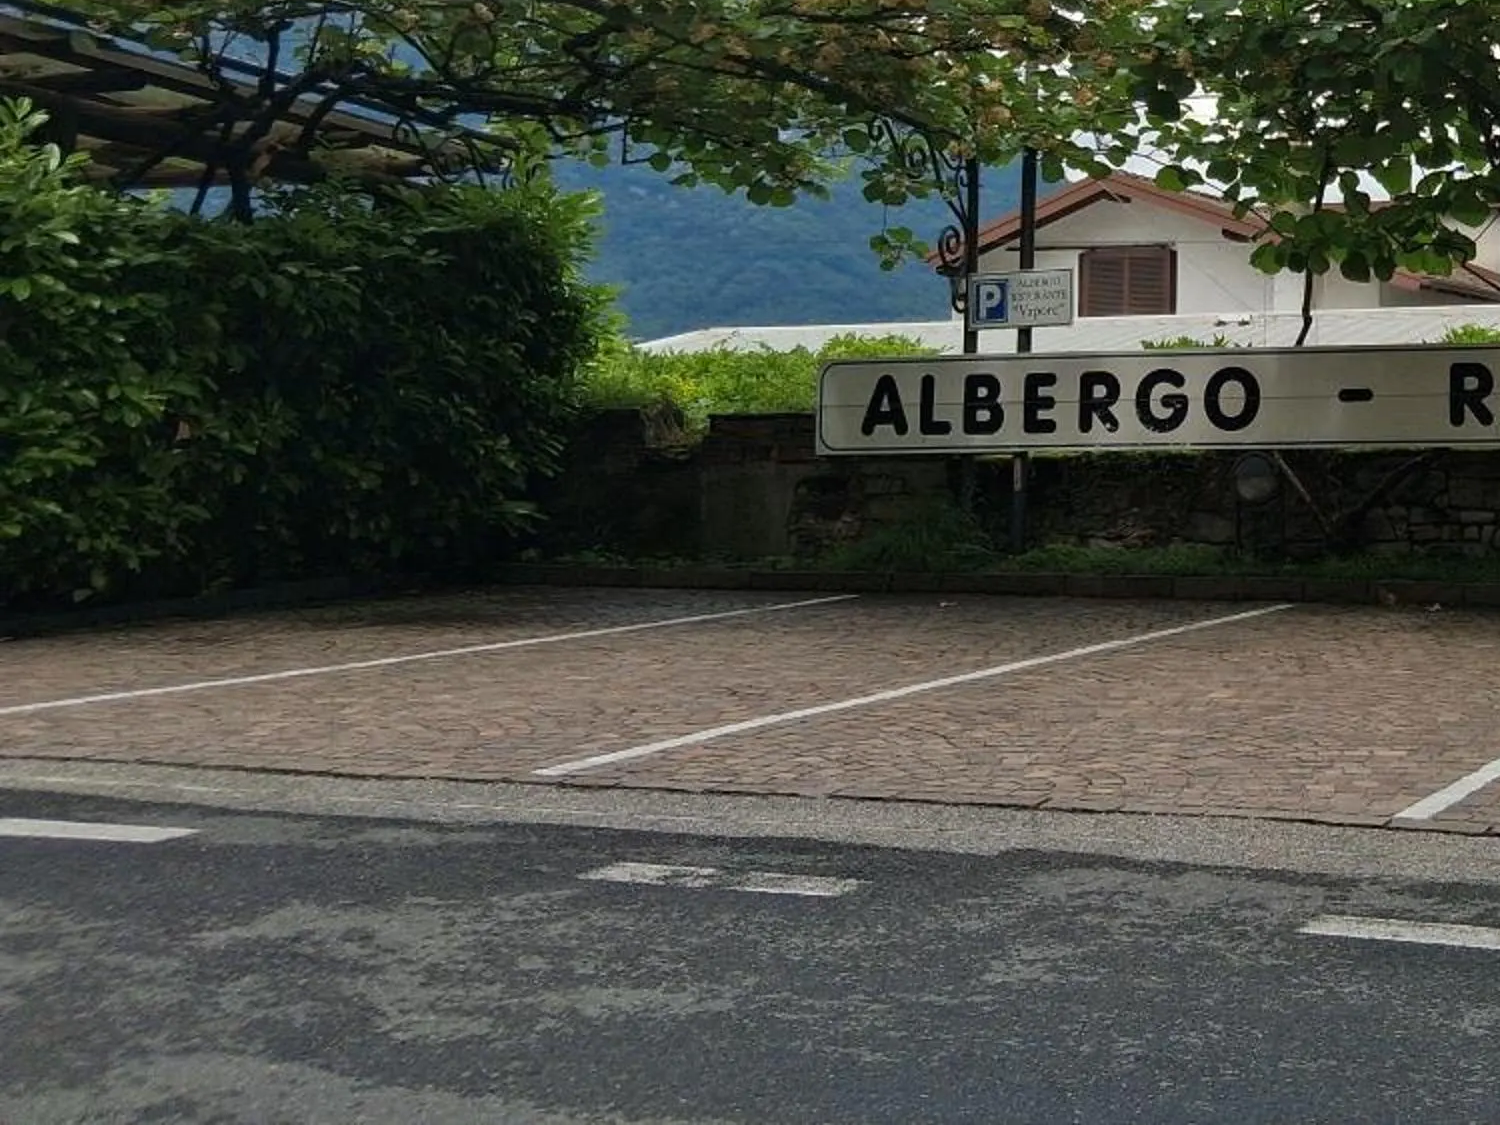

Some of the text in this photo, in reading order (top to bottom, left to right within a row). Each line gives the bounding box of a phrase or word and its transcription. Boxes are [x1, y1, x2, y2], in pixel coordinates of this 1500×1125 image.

[979, 283, 1002, 320] P
[860, 366, 1262, 437] ALBERGO
[1337, 387, 1375, 404] -
